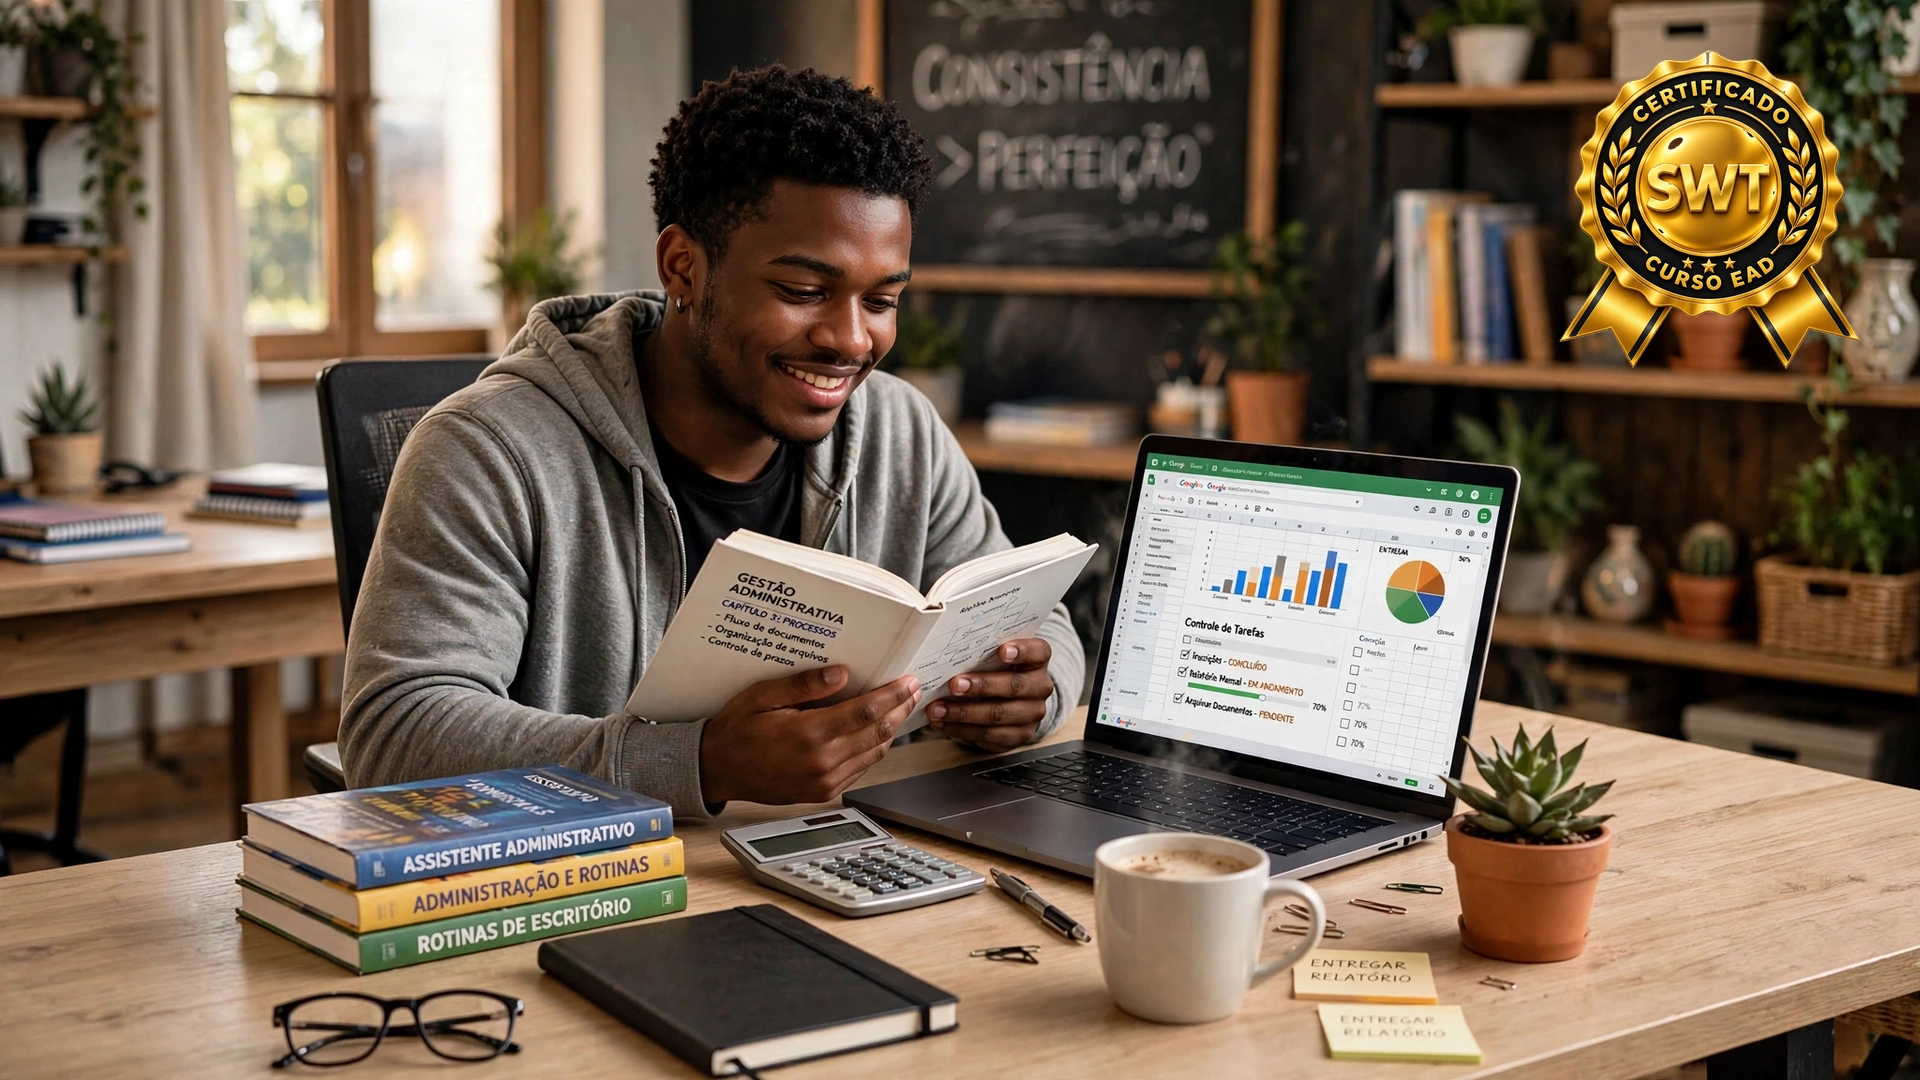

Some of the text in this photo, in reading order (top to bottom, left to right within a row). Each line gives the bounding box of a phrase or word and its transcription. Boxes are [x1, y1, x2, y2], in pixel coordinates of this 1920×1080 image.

[912, 31, 1211, 112] CONSISTÊNCIA
[977, 122, 1202, 204] PERFEIÇÃO
[737, 572, 796, 597] GESTÃO
[729, 584, 844, 625] ADMINISTRATIVA
[721, 599, 768, 619] CAPÍTULO
[782, 617, 838, 638] PROCESSOS
[724, 613, 750, 628] Fluxo
[753, 622, 765, 632] de
[768, 627, 826, 650] documentos
[1185, 617, 1265, 639] Controle de Tarefas
[708, 636, 749, 654] Controle
[751, 647, 763, 657] de
[763, 652, 795, 666] prazos
[715, 625, 773, 648] Organização
[775, 641, 787, 651] de
[789, 646, 829, 664] arquivos
[1259, 710, 1294, 724] PENDENTE
[1312, 702, 1327, 712] 70%
[1353, 720, 1368, 730] 70%
[1350, 738, 1365, 749] 70%
[403, 821, 636, 874] ASSISTENTE ADMINISTRATIVO
[413, 855, 650, 914] ADMINISTRAÇÃO E ROTINAS
[417, 897, 632, 955] ROTINAS DE ESCRITÓRIO
[1311, 959, 1407, 970] ENTREGAR
[1311, 971, 1412, 983] RELATÓRIO
[1340, 1015, 1437, 1025] ENTREGAR
[1344, 1028, 1447, 1038] RELATÓRIO
